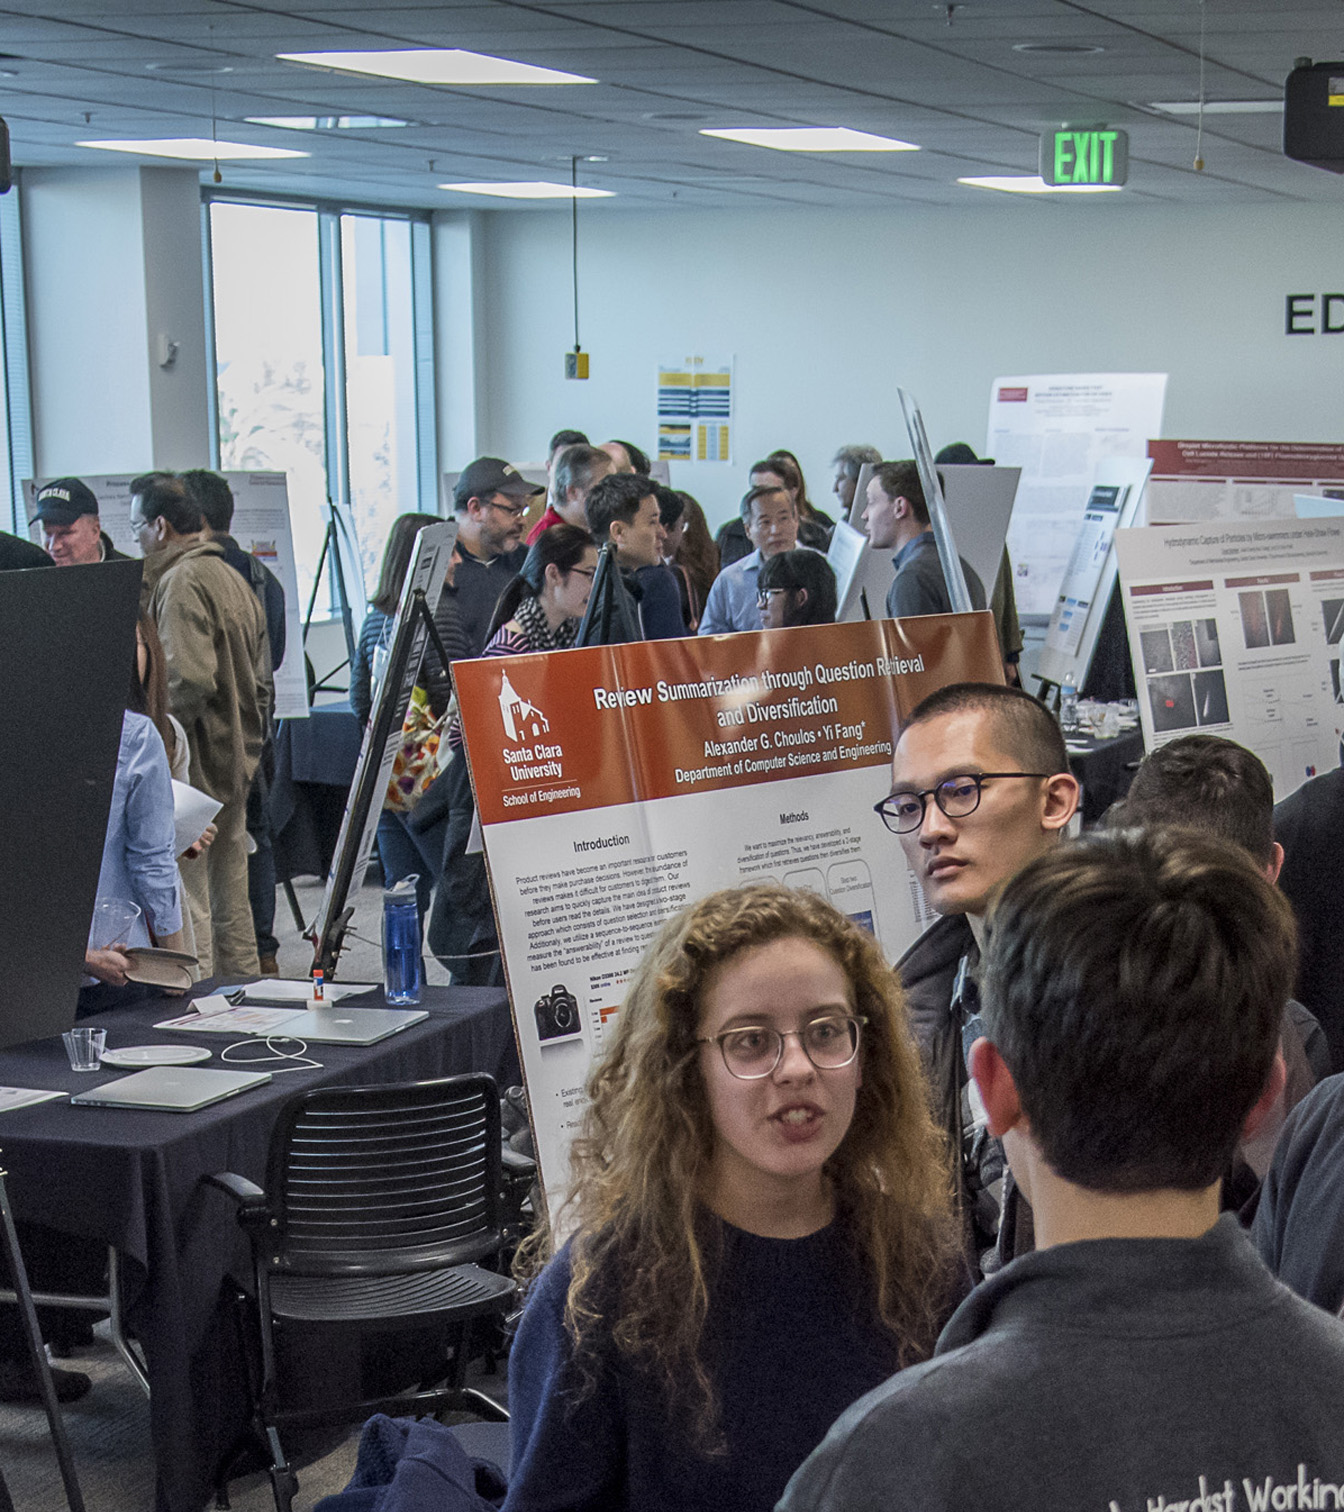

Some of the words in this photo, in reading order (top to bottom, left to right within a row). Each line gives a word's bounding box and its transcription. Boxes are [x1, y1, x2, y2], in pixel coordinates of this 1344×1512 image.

[1055, 131, 1117, 183] EXIT
[593, 686, 653, 710] Review
[656, 673, 760, 703] Summarization
[761, 666, 814, 691] through
[815, 660, 875, 685] Question
[876, 654, 925, 681] Retrieval
[716, 703, 745, 728] and
[746, 695, 839, 724] Diversification
[703, 736, 758, 758] Alexander
[760, 733, 774, 750] G.
[774, 727, 816, 748] Choulos
[822, 725, 834, 741] Yi
[502, 746, 534, 765] Santa
[534, 744, 563, 761] Clara
[674, 763, 733, 784] Department
[733, 760, 744, 775] of
[744, 752, 787, 773] Computer
[787, 748, 821, 767] Science
[822, 746, 838, 763] and
[839, 740, 892, 760] Engineering
[510, 760, 563, 782] University
[502, 792, 529, 808] School
[529, 791, 538, 803] of
[538, 786, 581, 803] Engineering
[779, 810, 809, 824] Methods
[573, 834, 631, 853] Introduction
[516, 875, 538, 885] Product
[539, 872, 561, 881] reviews
[561, 869, 575, 877] have
[576, 865, 598, 875] become
[656, 850, 688, 861] customers
[519, 886, 538, 895] before
[538, 884, 552, 893] they
[552, 881, 568, 890] make
[569, 877, 594, 888] purchase
[532, 895, 555, 905] reviews
[555, 892, 574, 900] makes
[579, 886, 599, 896] difficult
[607, 880, 635, 891] customers
[666, 872, 680, 881] Our
[525, 906, 550, 917] research
[551, 904, 564, 913] aims
[572, 899, 590, 910] quickly
[591, 896, 612, 905] capture
[667, 881, 691, 891] reviews
[528, 928, 555, 940] approach
[555, 925, 572, 934] which
[573, 920, 596, 931] consists
[603, 915, 626, 926] question
[532, 918, 551, 927] before
[552, 915, 568, 924] users
[569, 912, 581, 921] read
[527, 951, 552, 961] measure
[616, 936, 634, 945] review
[531, 964, 542, 972] has
[543, 961, 558, 970] been
[558, 957, 575, 967] found
[591, 950, 614, 961] effective
